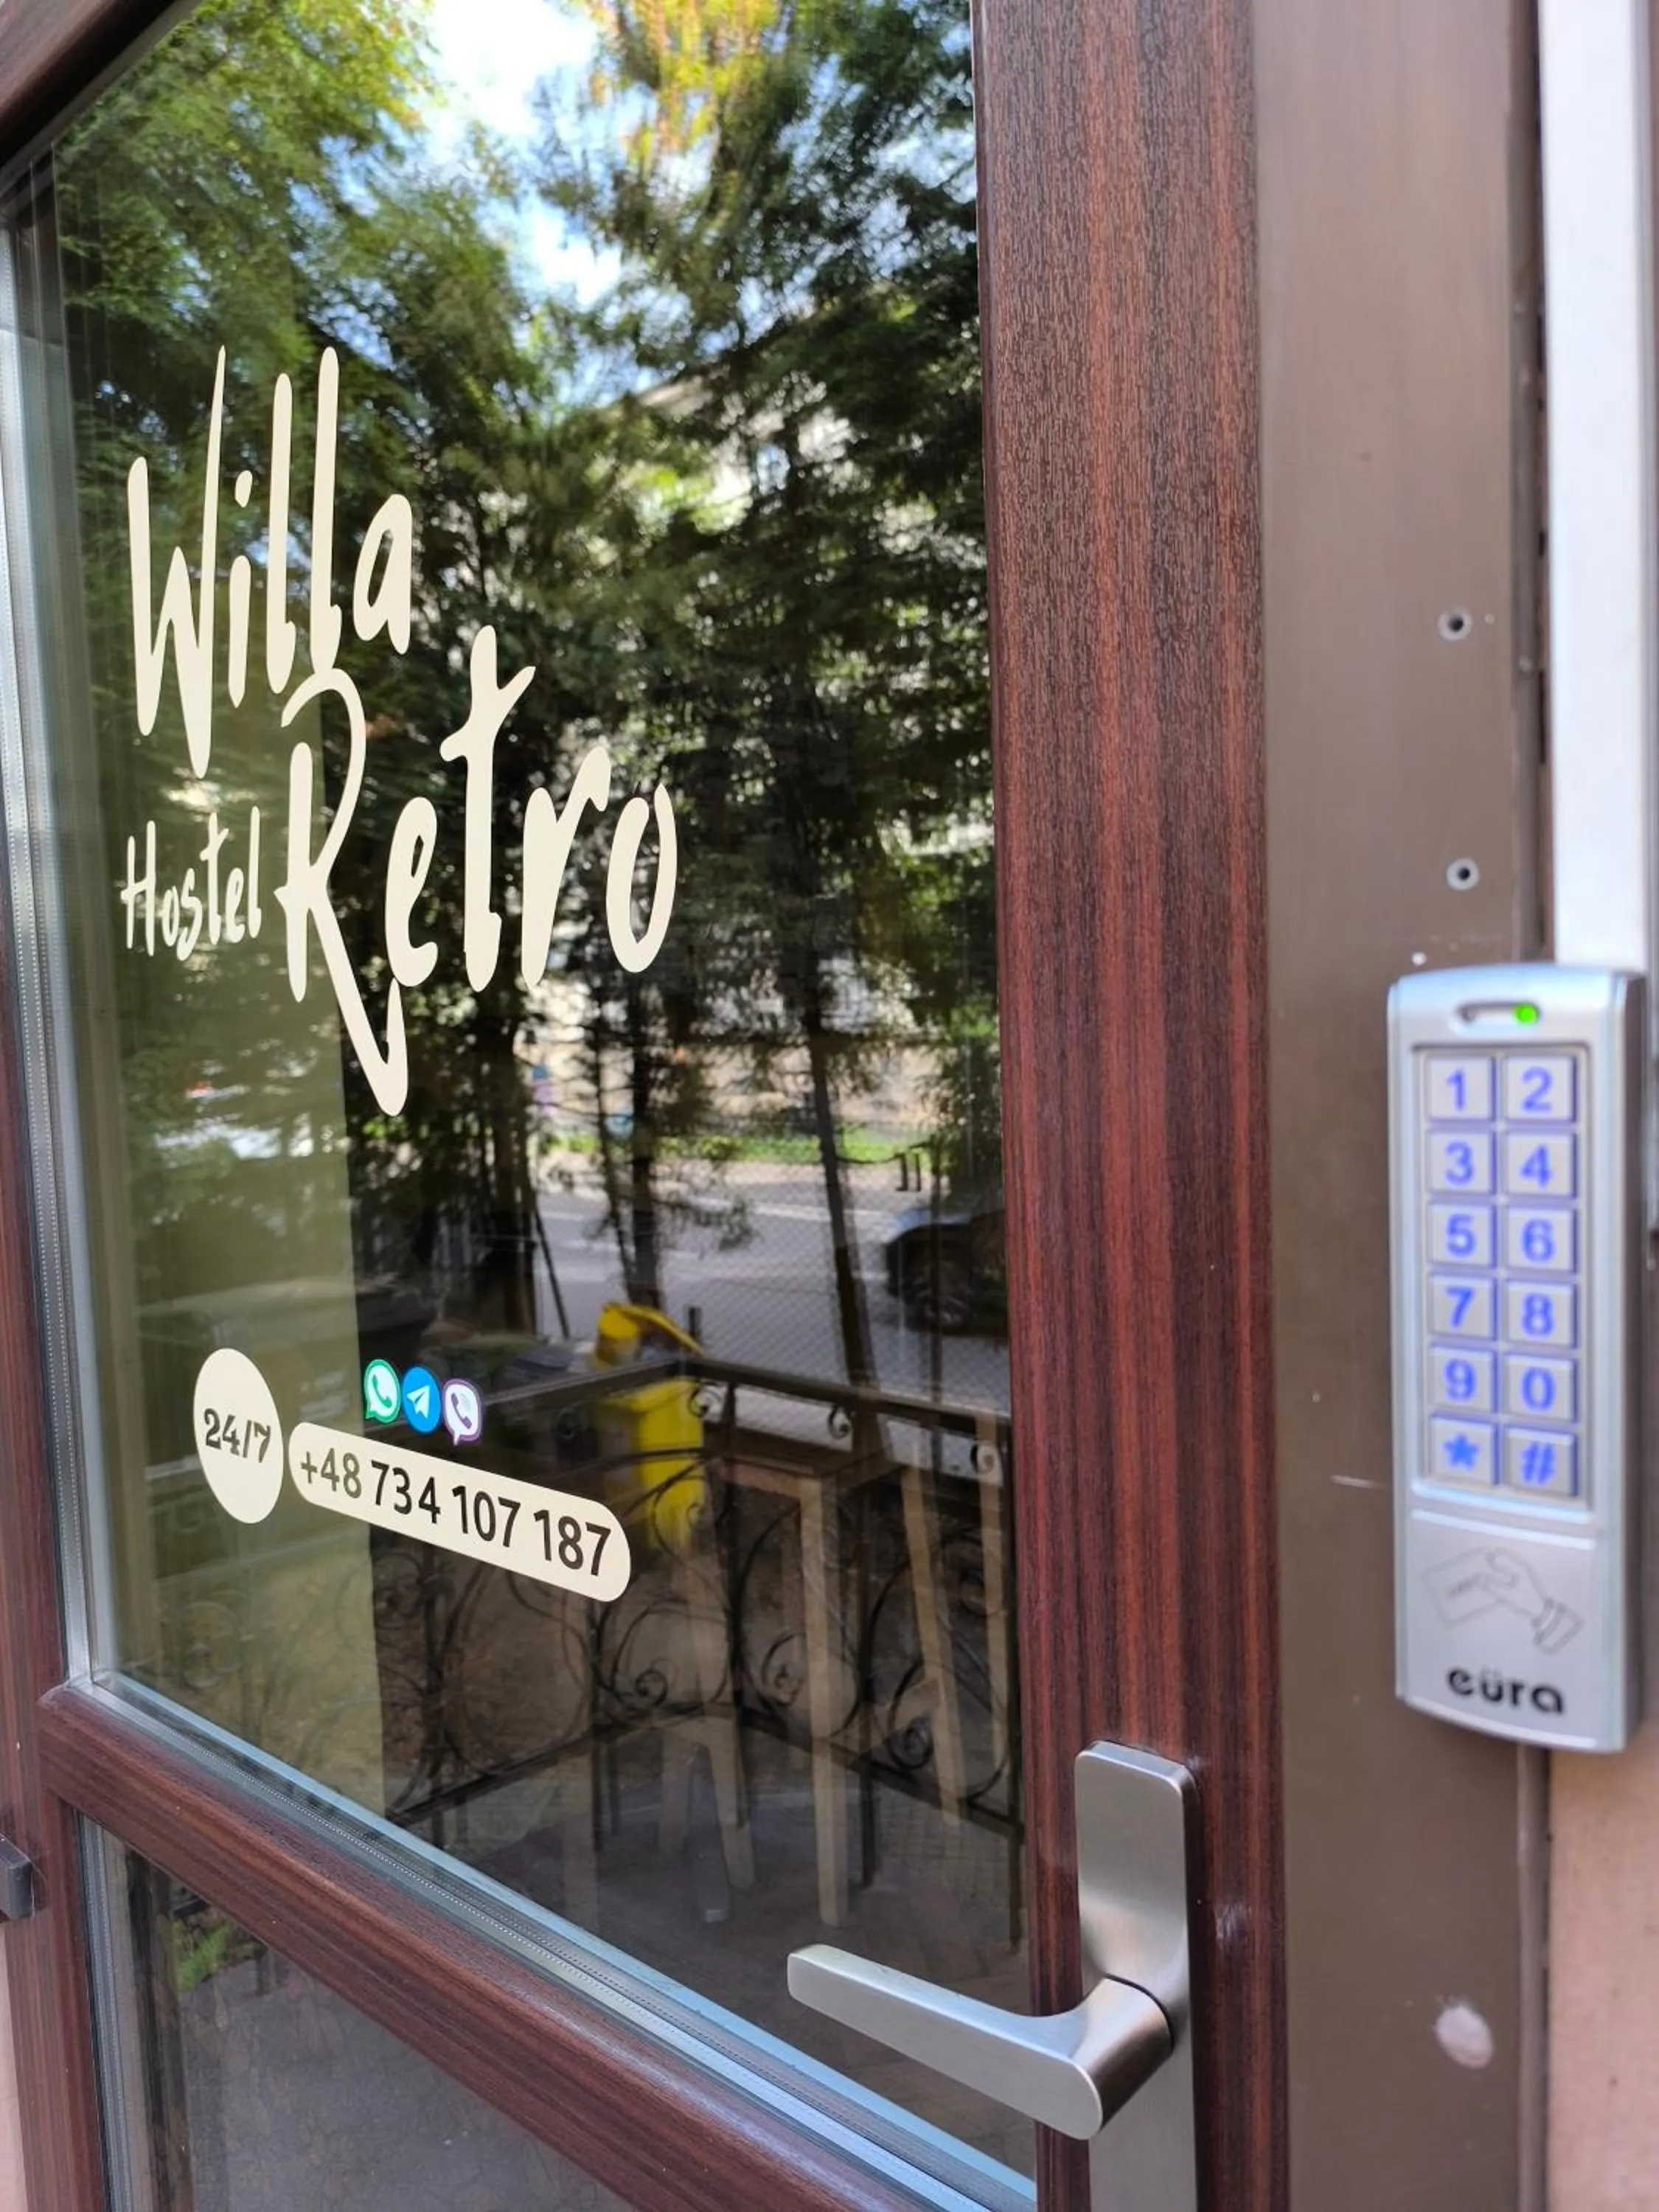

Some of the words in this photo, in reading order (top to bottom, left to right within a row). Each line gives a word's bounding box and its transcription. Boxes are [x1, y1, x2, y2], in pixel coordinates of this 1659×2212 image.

[128, 345, 412, 778] Willa
[120, 806, 262, 961] Hostel
[274, 625, 677, 1116] Retro
[1446, 1068, 1466, 1111] 1
[1521, 1066, 1554, 1112] 2
[1444, 1141, 1474, 1185] 3
[1520, 1145, 1553, 1186] 4
[1446, 1214, 1475, 1258] 5
[1522, 1219, 1556, 1262] 6
[1445, 1287, 1473, 1328] 7
[1520, 1293, 1555, 1338] 8
[1444, 1358, 1475, 1401] 9
[1520, 1366, 1556, 1411] 0
[203, 1408, 271, 1464] 24/7
[1520, 1440, 1557, 1485] #
[301, 1447, 362, 1499] +48
[371, 1460, 440, 1524] 734
[452, 1486, 521, 1548] 107
[534, 1509, 611, 1576] 187
